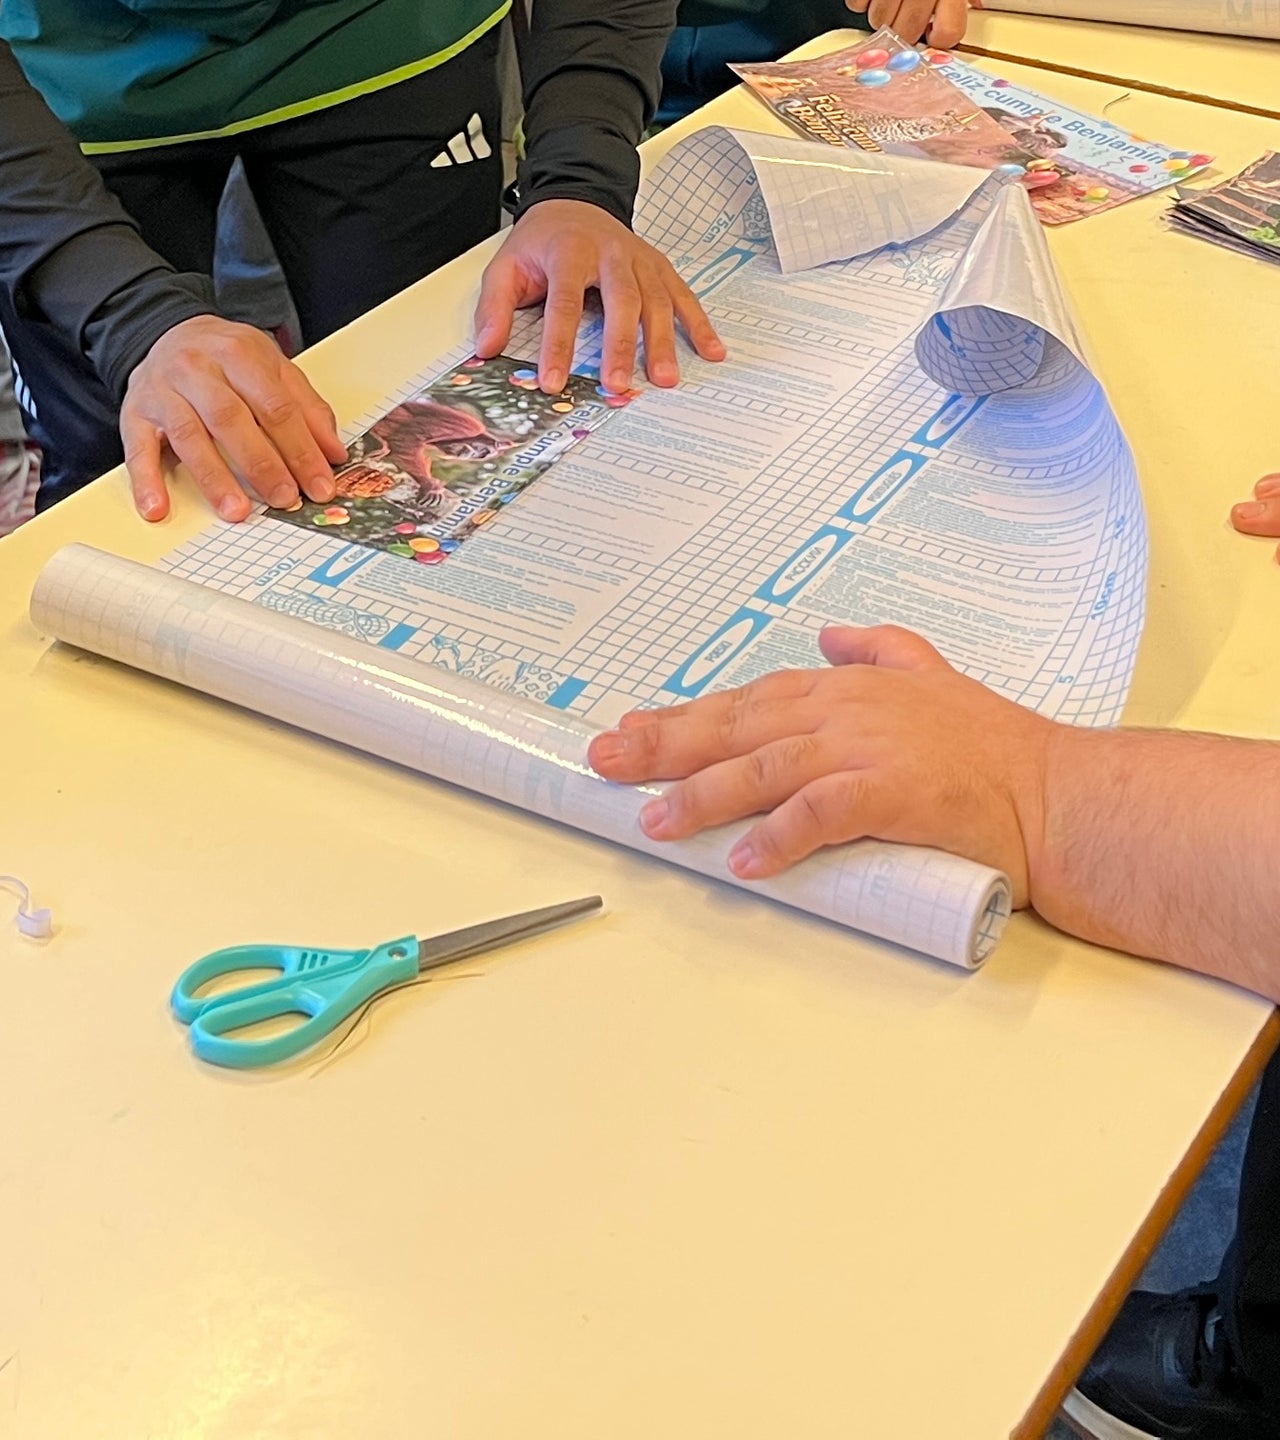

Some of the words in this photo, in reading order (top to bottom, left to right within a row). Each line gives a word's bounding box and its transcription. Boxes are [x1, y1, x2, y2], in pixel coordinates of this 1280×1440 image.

[938, 65, 986, 92] Feliz
[703, 210, 736, 244] 75cm
[562, 403, 603, 431] Feliz
[503, 431, 563, 476] cumple
[254, 557, 302, 587] 70cm
[1090, 570, 1118, 621] 10cm
[1058, 673, 1075, 684] 5
